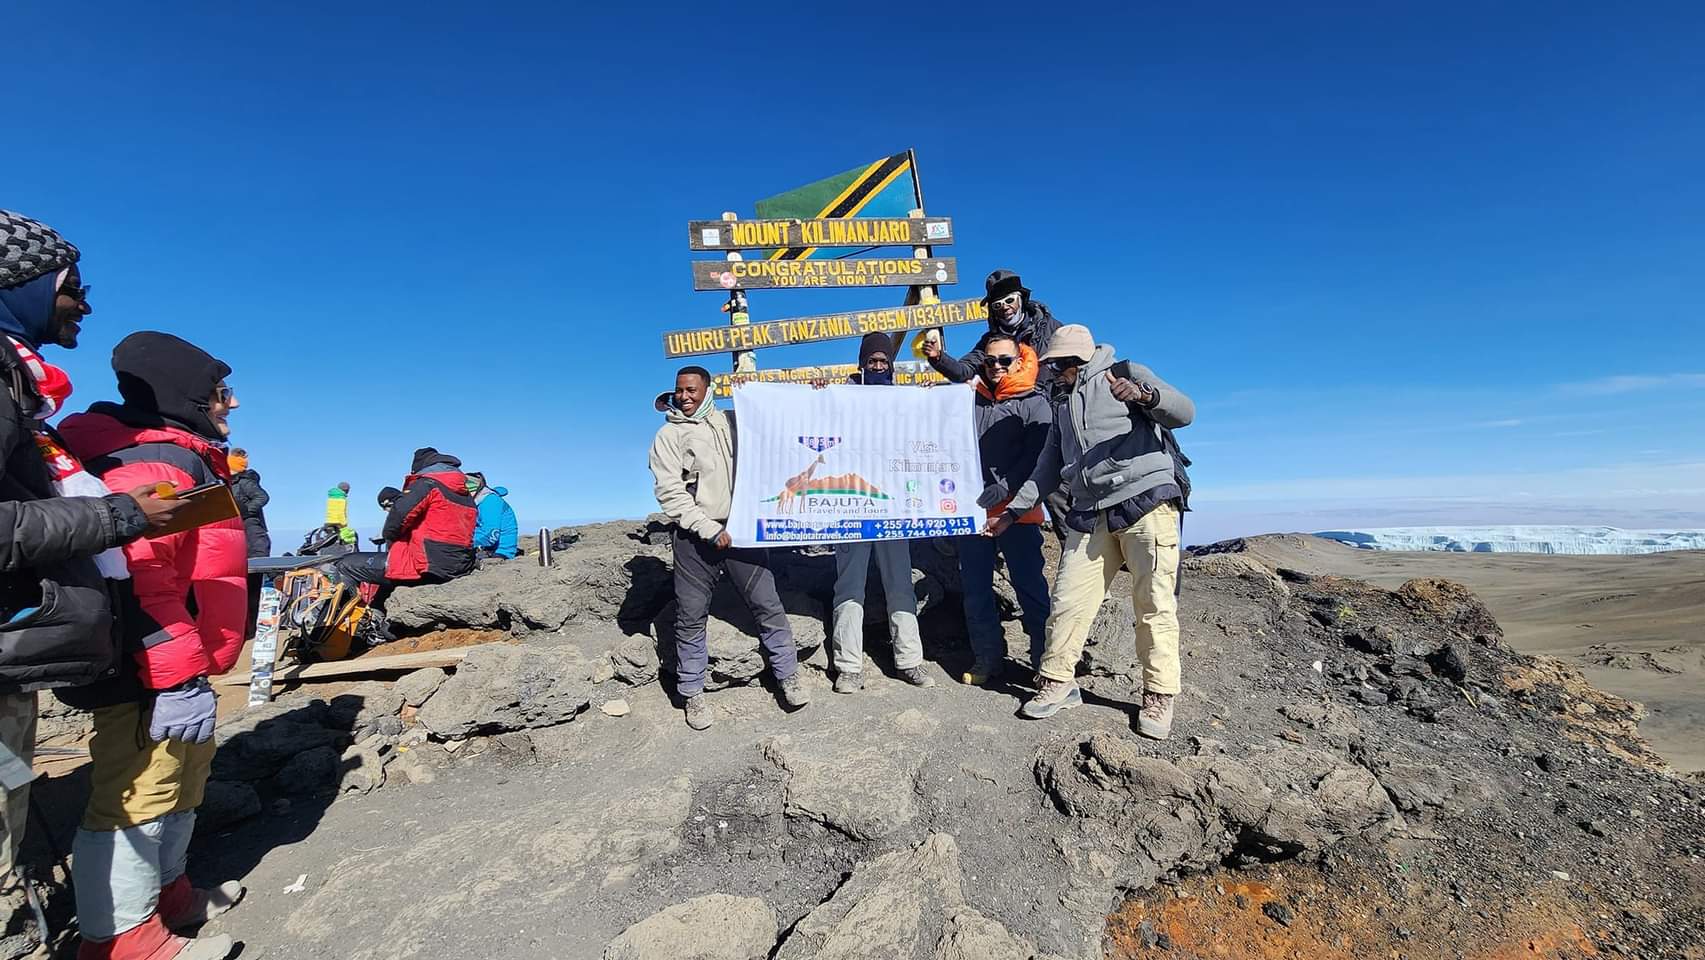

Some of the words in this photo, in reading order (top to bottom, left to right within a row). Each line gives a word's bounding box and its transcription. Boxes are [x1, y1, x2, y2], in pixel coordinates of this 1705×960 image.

[731, 222, 790, 246] MOUNT
[801, 221, 910, 244] KILIMANJARO
[732, 260, 923, 277] CONGRATULATIONS
[773, 276, 798, 286] YOU
[804, 275, 828, 286] ARE
[836, 275, 867, 286] NOW
[872, 274, 888, 285] AT
[668, 330, 725, 354] UHURU
[779, 365, 828, 380] HIGHEST
[808, 497, 875, 507] BAJUTA
[808, 507, 841, 515] Travels
[863, 506, 888, 514] Tours
[875, 520, 902, 529] +255
[928, 519, 947, 528] 920
[949, 518, 969, 527] 913
[876, 530, 904, 538] +255
[908, 529, 926, 537] 744
[929, 528, 949, 536] 096
[951, 527, 972, 535] 709
